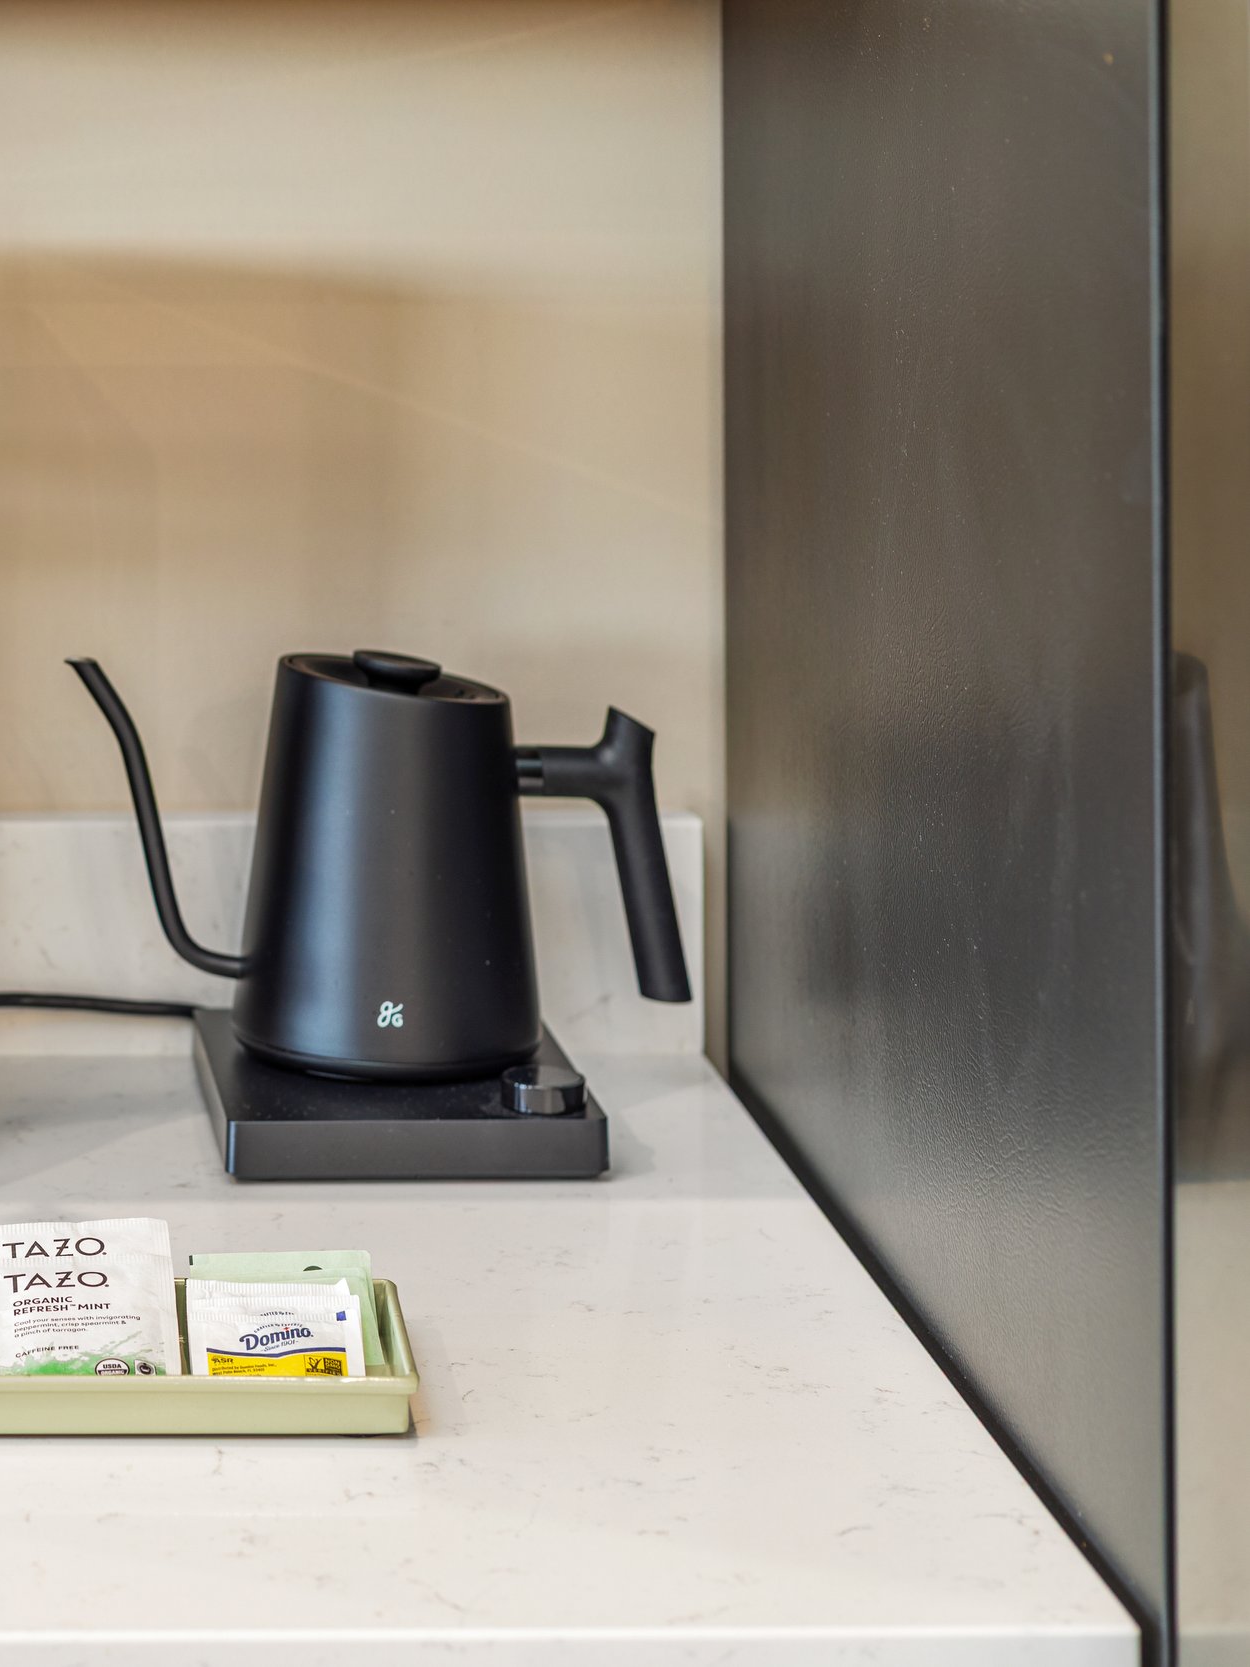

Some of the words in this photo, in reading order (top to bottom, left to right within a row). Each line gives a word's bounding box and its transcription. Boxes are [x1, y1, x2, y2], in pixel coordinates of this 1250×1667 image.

[2, 1237, 107, 1259] TAZO
[4, 1271, 109, 1293] TAZO
[12, 1296, 73, 1307] ORGANIC
[78, 1302, 111, 1311] MINT
[14, 1319, 31, 1327] Cool
[20, 1329, 41, 1337] pinch
[239, 1327, 312, 1351] Domino
[15, 1345, 56, 1359] CAFFEINE
